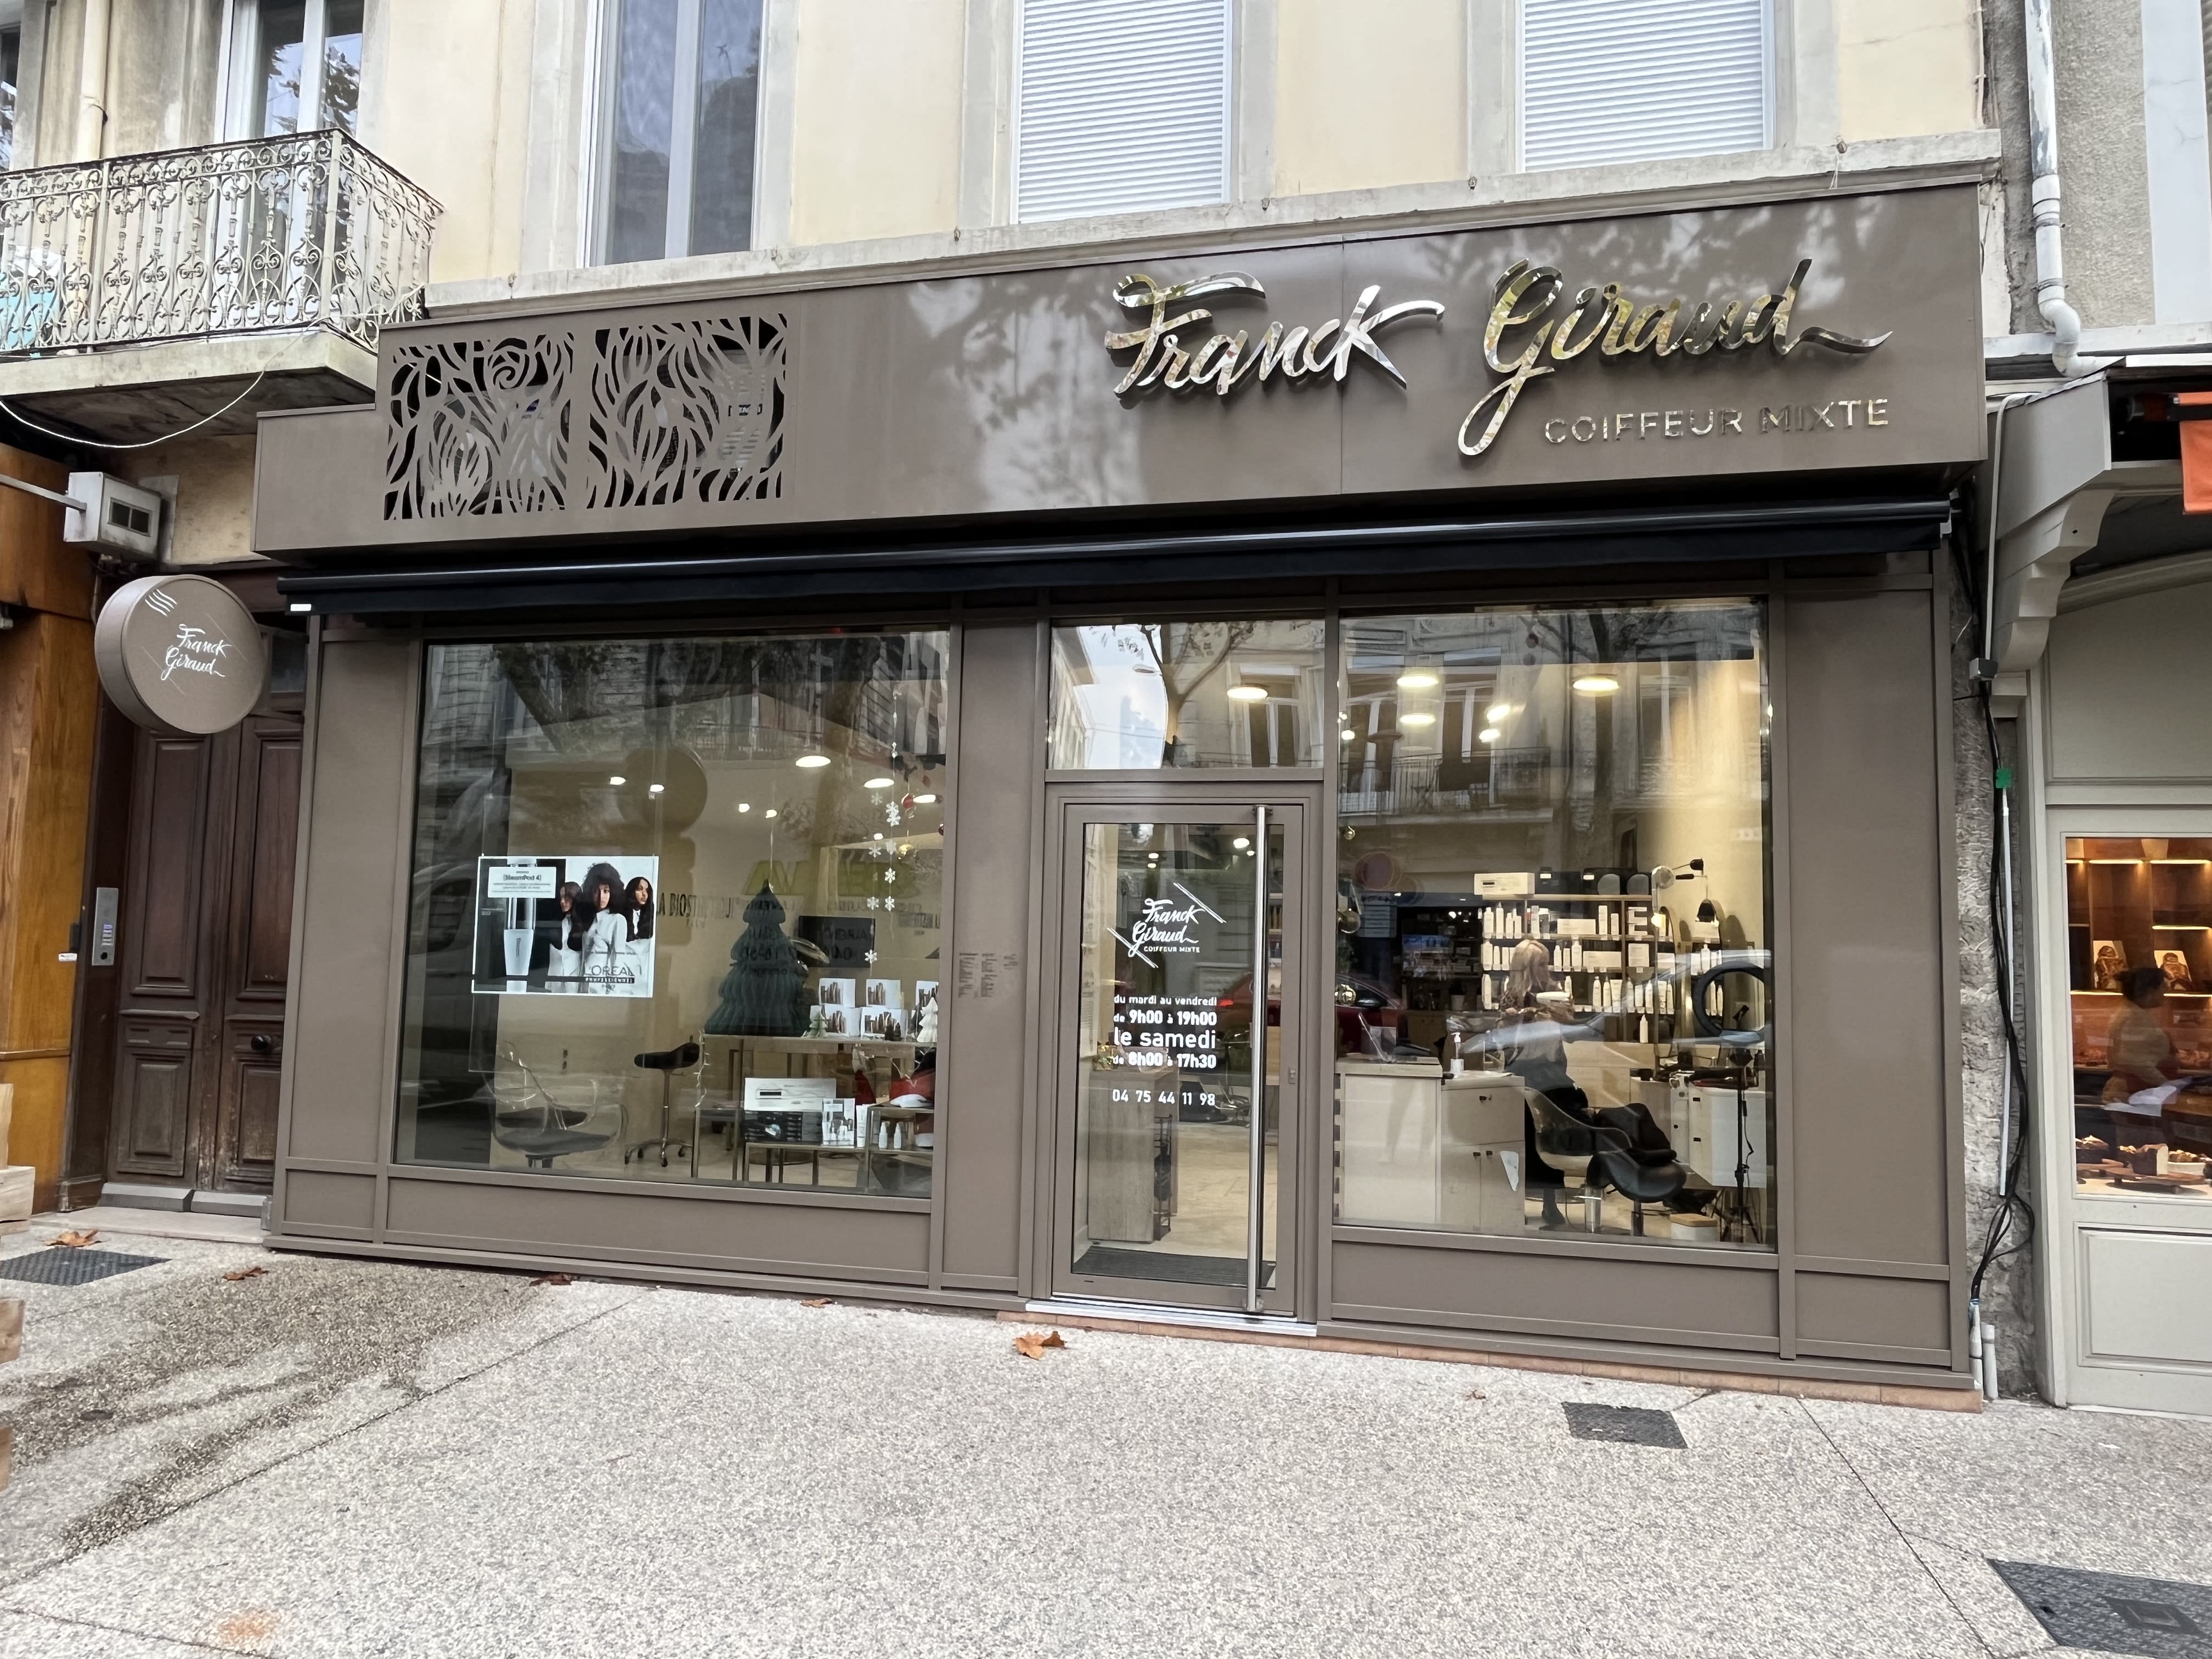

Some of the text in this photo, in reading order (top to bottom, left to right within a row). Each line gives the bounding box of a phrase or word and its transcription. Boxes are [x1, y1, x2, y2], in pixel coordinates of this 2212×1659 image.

[1104, 258, 1893, 456] Franck Giraud
[1544, 398, 1889, 443] COIFFEUR MIXTE
[177, 624, 232, 658] Franck
[161, 645, 226, 680] Giraud
[1142, 898, 1206, 925] Franck
[1128, 921, 1199, 957] Giraud
[1114, 994, 1217, 1006] du mardi au vendredi
[1113, 1009, 1217, 1026] de 9h00 à 19h00
[1114, 1026, 1216, 1049] le samedi
[1113, 1051, 1217, 1069] de 8h00 à 17h30
[1112, 1088, 1216, 1106] 04 75 44 11 98
